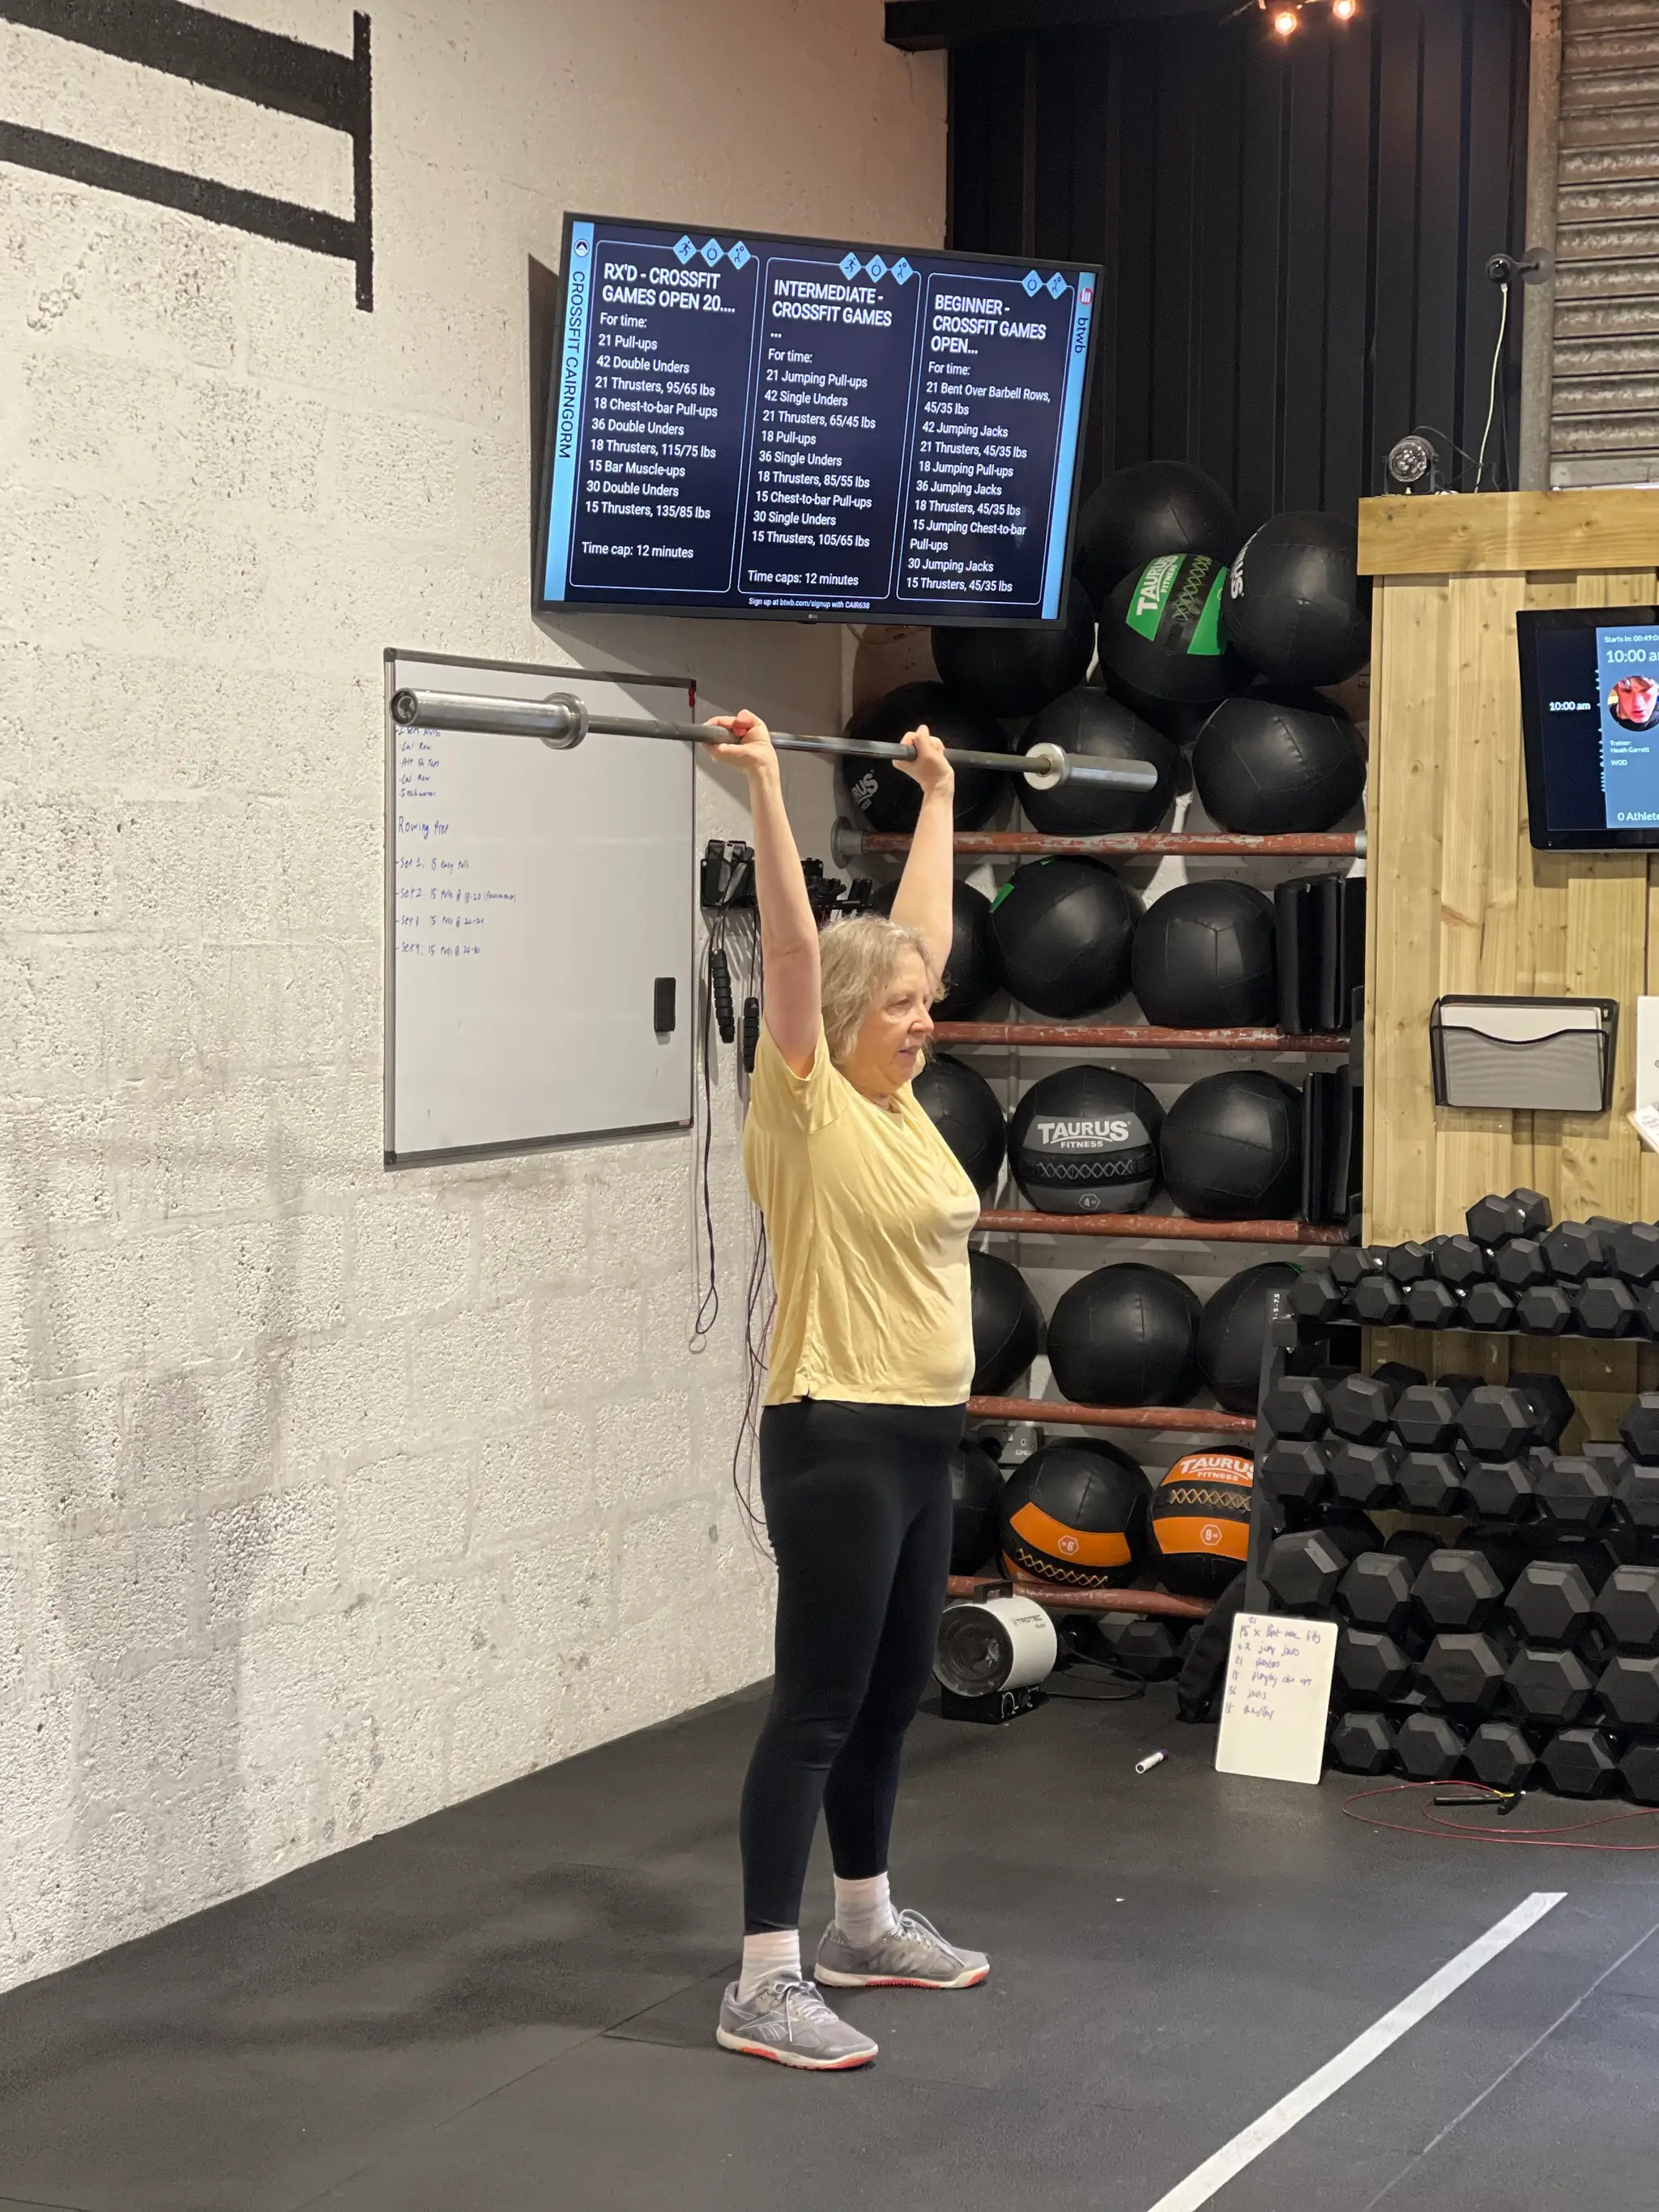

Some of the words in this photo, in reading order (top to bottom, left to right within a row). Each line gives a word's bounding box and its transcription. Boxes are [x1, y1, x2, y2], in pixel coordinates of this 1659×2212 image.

[603, 262, 638, 282] RX'D
[649, 267, 721, 290] CROSSFIT
[602, 284, 657, 306] GAMES
[659, 289, 700, 310] OPEN
[774, 279, 876, 305] INTERMEDIATE
[569, 271, 585, 353] CROSSFIT
[772, 300, 842, 322] CROSSFIT
[842, 306, 893, 327] GAMES
[934, 293, 1004, 316] BEGINNER
[599, 311, 619, 327] For
[620, 314, 648, 328] time:
[932, 314, 999, 335] CROSSFIT
[999, 320, 1047, 340] GAMES
[598, 333, 612, 347] 21
[614, 334, 658, 352] Pull-ups
[1075, 317, 1089, 353] btwb
[930, 335, 979, 356] OPEN...
[595, 354, 611, 368] 42
[612, 355, 651, 371] Double
[652, 359, 690, 374] Unders
[768, 348, 786, 361] For
[787, 349, 813, 364] time:
[928, 361, 945, 374] For
[945, 362, 971, 376] time:
[595, 375, 608, 389] 21
[611, 376, 664, 395] Thrusters,
[666, 381, 698, 395] 95/65
[699, 382, 716, 397] lbs
[766, 368, 778, 382] 21
[781, 369, 826, 388] Jumping
[827, 373, 868, 391] Pull-ups
[764, 389, 778, 402] 42
[779, 390, 812, 406] Single
[812, 392, 849, 407] Unders
[926, 381, 938, 393] 21
[940, 382, 963, 395] Bent
[964, 383, 987, 397] Over
[988, 385, 1022, 399] Barbell
[1022, 388, 1051, 404] Rows,
[559, 357, 578, 459] CAIRNGORM
[594, 396, 608, 410] 18
[609, 397, 675, 415] Chest-to-bar
[676, 402, 719, 420] Pull-ups
[923, 400, 953, 415] 45/35
[954, 402, 970, 416] lbs
[591, 417, 606, 431] 36
[608, 418, 646, 433] Double
[647, 421, 684, 436] Unders
[762, 409, 775, 422] 21
[778, 410, 828, 428] Thrusters,
[829, 414, 859, 428] 65/45
[860, 415, 876, 429] lbs
[761, 429, 774, 442] 18
[775, 430, 817, 447] Pull-ups
[922, 421, 936, 433] 42
[936, 421, 979, 438] Jumping
[979, 425, 1009, 438] Jacks
[591, 438, 604, 452] 18
[605, 439, 659, 457] Thrusters,
[661, 443, 699, 458] 115/75
[700, 445, 717, 459] lbs
[919, 440, 932, 452] 21
[935, 441, 982, 458] Thrusters,
[983, 444, 1012, 458] 45/35
[1013, 446, 1028, 459] lbs
[758, 450, 773, 463] 36
[774, 451, 806, 467] Single
[807, 452, 842, 467] Unders
[588, 459, 603, 472] 15
[603, 459, 624, 473] Bar
[625, 461, 686, 480] Muscle-ups
[919, 460, 932, 472] 18
[932, 461, 975, 477] Jumping
[975, 463, 1014, 480] Pull-ups
[586, 479, 601, 493] 30
[602, 480, 641, 495] Double
[642, 483, 680, 497] Unders
[757, 470, 770, 483] 18
[772, 470, 822, 488] Thrusters,
[823, 474, 854, 488] 85/55
[855, 475, 871, 489] lbs
[915, 479, 929, 492] 36
[930, 480, 973, 497] Jumping
[973, 483, 1003, 496] Jacks
[585, 500, 599, 514] 15
[600, 501, 654, 518] Thrusters,
[656, 504, 693, 519] 135/85
[694, 506, 711, 519] lbs
[755, 490, 769, 502] 15
[770, 490, 832, 506] Chest-to-bar
[832, 494, 872, 510] Pull-ups
[915, 499, 928, 511] 18
[928, 499, 975, 515] Thrusters,
[976, 502, 1005, 515] 45/35
[1006, 503, 1021, 517] lbs
[753, 510, 767, 523] 30
[768, 510, 800, 527] Single
[801, 512, 837, 527] Unders
[912, 519, 926, 531] 15
[926, 519, 969, 536] Jumping
[970, 521, 1027, 536] Chest-to-bar
[752, 530, 766, 542] 15
[766, 530, 816, 547] Thrusters,
[818, 533, 854, 547] 105/65
[855, 534, 870, 548] lbs
[910, 537, 949, 553] Pull-ups
[581, 540, 609, 555] Time
[610, 544, 633, 558] cap:
[636, 544, 650, 557] 12
[651, 544, 694, 559] minutes
[907, 557, 921, 570] 30
[922, 557, 965, 574] Jumping
[965, 560, 995, 573] Jacks
[747, 569, 774, 583] Time
[774, 573, 803, 586] caps:
[804, 572, 818, 584] 12
[818, 573, 859, 586] minutes
[906, 576, 919, 588] 15
[920, 576, 967, 592] Thrusters,
[968, 579, 997, 592] 45/35
[998, 579, 1013, 592] lbs
[1137, 554, 1179, 616] TAURUS
[748, 597, 763, 607] Sign
[763, 599, 772, 607] up
[779, 598, 831, 609] btwb.com/signup
[831, 600, 845, 609] with
[845, 600, 871, 609] CAIR638
[1606, 649, 1647, 663] 10:00
[1549, 701, 1576, 711] 10:00
[1576, 702, 1591, 711] am
[1617, 812, 1625, 822] 0
[1037, 1121, 1129, 1145] TAURUS
[1060, 1140, 1104, 1149] FITNESS
[1197, 1471, 1239, 1481] FITNESS
